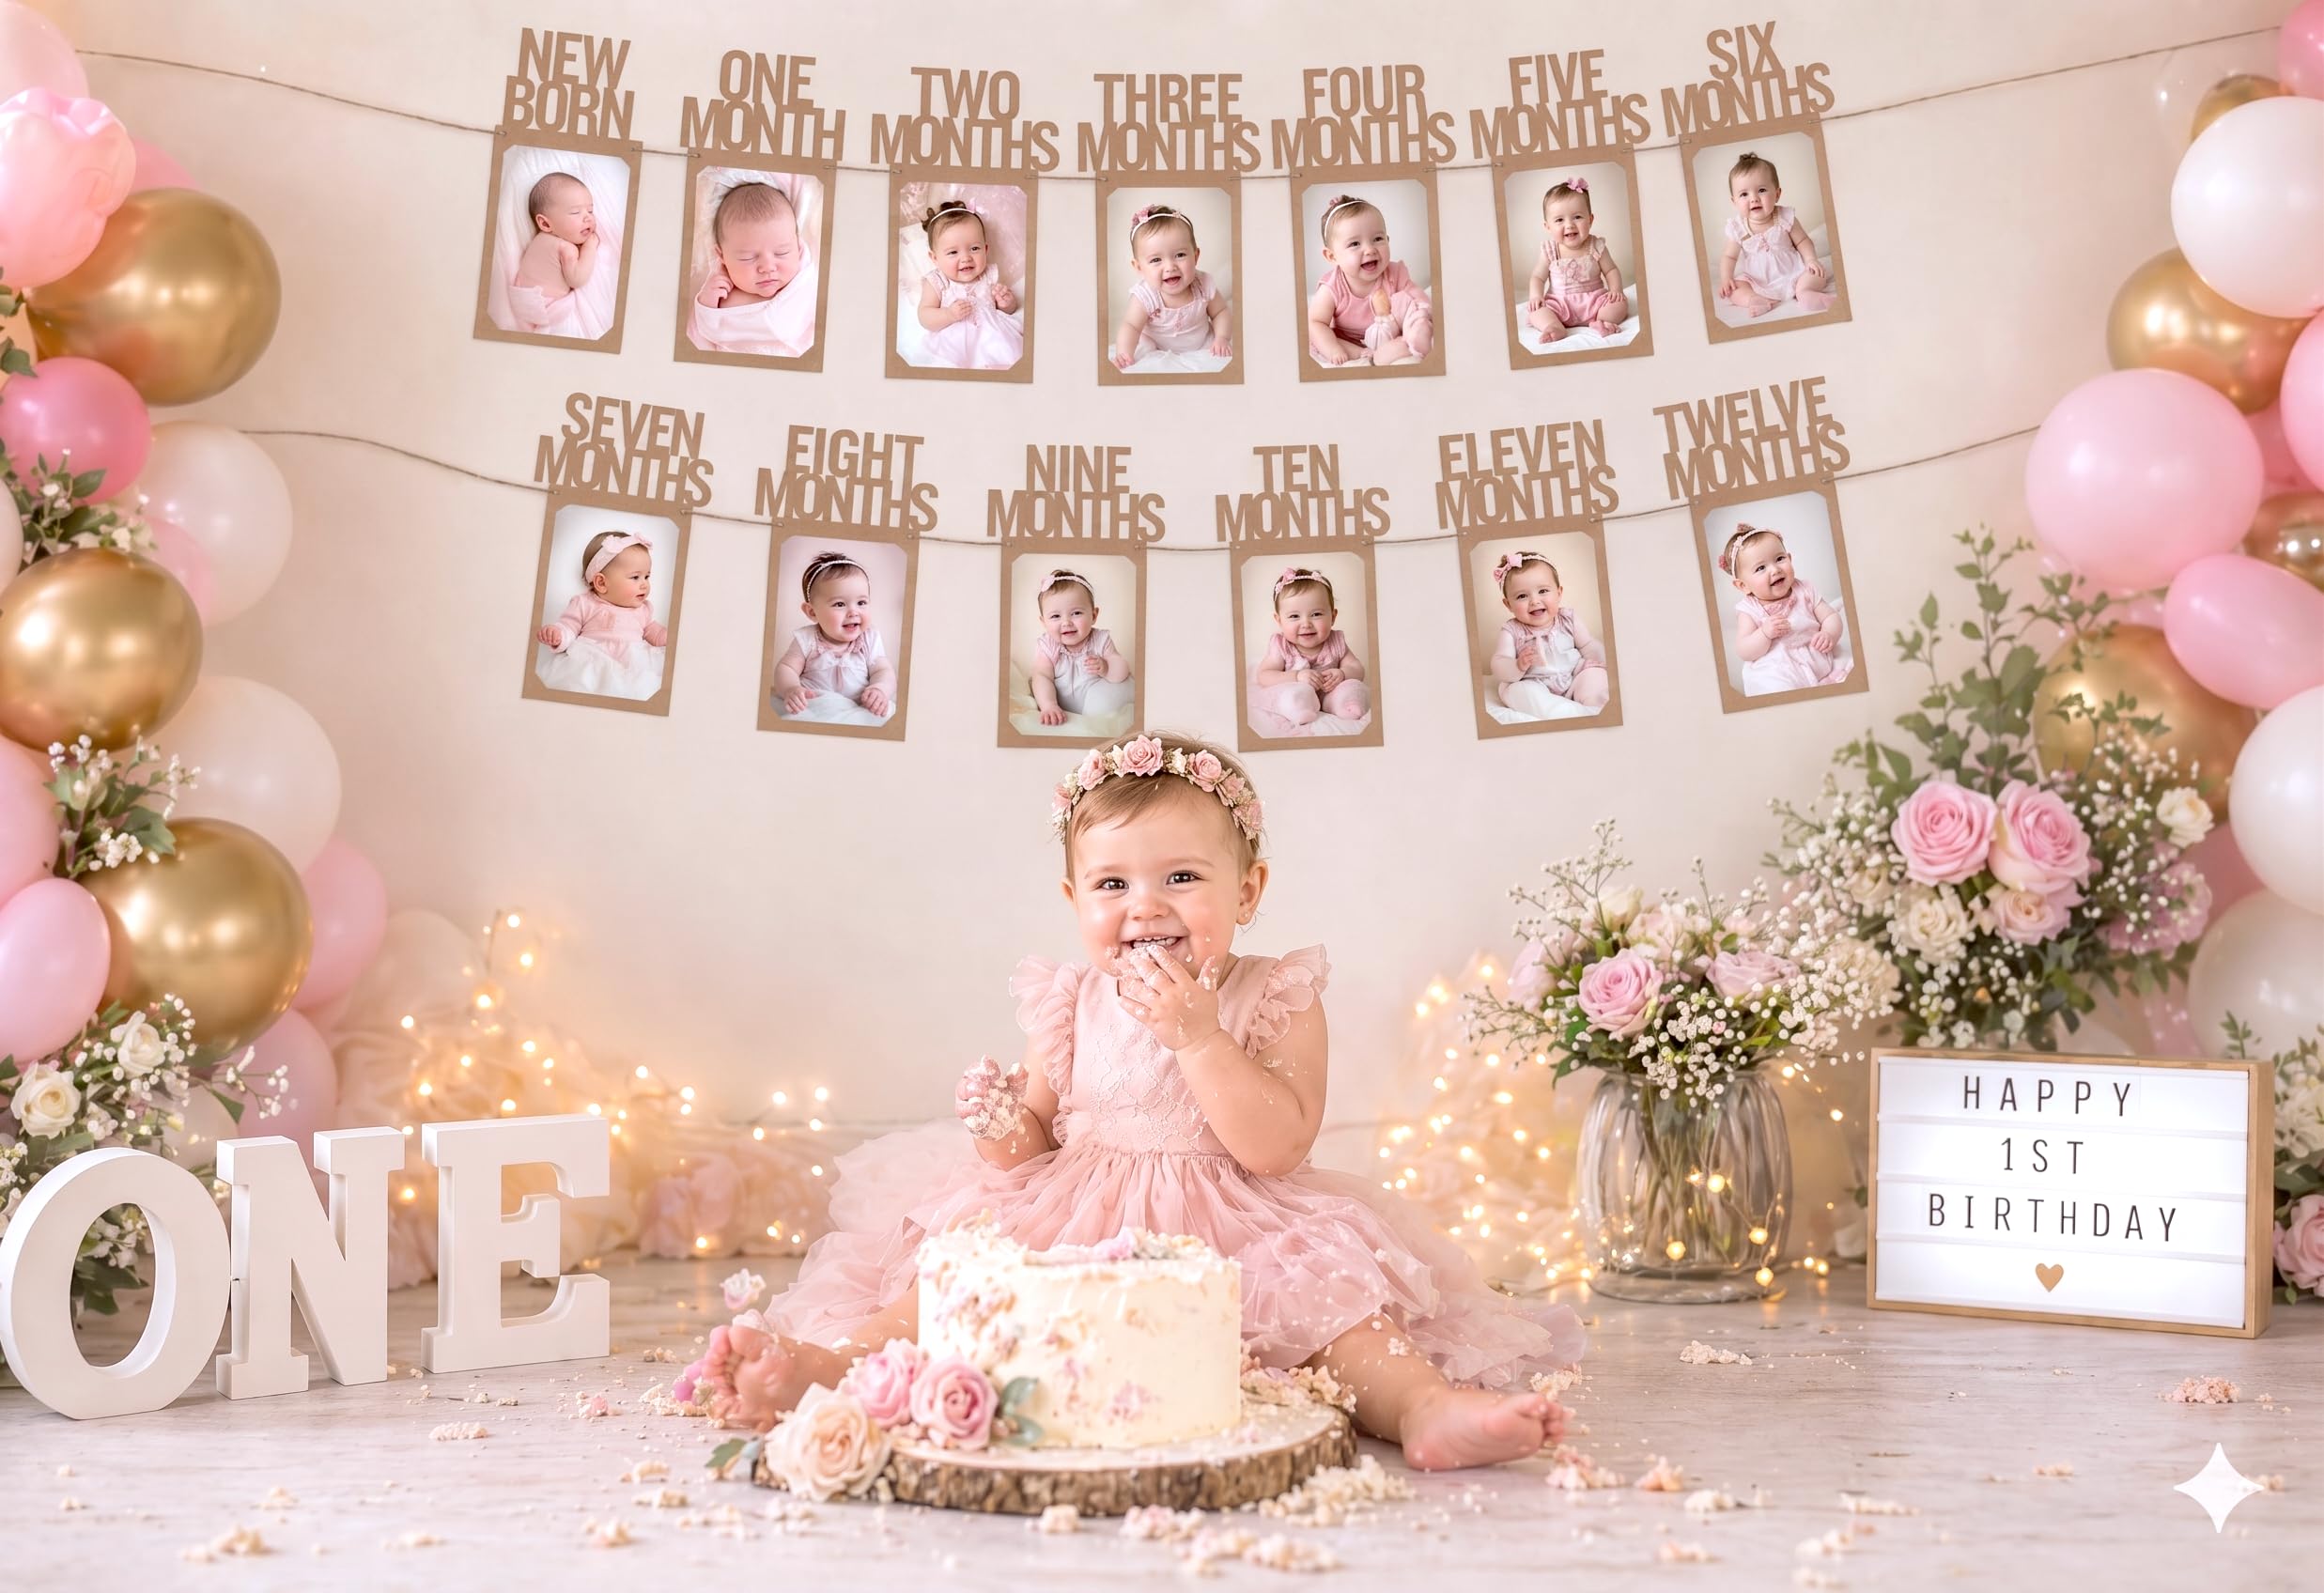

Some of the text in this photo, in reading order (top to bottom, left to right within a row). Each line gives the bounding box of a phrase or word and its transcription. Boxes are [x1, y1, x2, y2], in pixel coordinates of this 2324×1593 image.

[517, 27, 631, 88] NEW
[719, 49, 816, 108] ONE
[1508, 48, 1607, 108] FIVE
[1706, 21, 1783, 82] SIX
[504, 74, 635, 139] BORN
[910, 67, 1020, 120] TWO
[1094, 72, 1243, 124] THREE
[1303, 64, 1425, 120] FOUR
[1661, 61, 1836, 137] MONTHS
[680, 96, 845, 161] MONTH
[870, 113, 1060, 171] MONTHS
[1077, 120, 1262, 172] MONTHS
[1272, 111, 1456, 169] MONTHS
[1469, 92, 1651, 159] MONTHS
[561, 392, 705, 458] SEVEN
[1652, 376, 1833, 453] TWELVE
[534, 434, 714, 507] MONTHS
[787, 424, 924, 482] EIGHT
[1026, 444, 1132, 494] NINE
[1253, 443, 1340, 492] TEN
[1439, 418, 1605, 479] ELEVEN
[1664, 420, 1851, 500] MONTHS
[754, 467, 938, 532] MONTHS
[986, 488, 1165, 542] MONTHS
[1215, 487, 1390, 542] MONTHS
[1435, 463, 1619, 530] MONTHS
[1963, 1075, 2130, 1117] HAPPY
[2001, 1137, 2084, 1174] 1ST
[1929, 1193, 2176, 1242] BIRTHDAY
[0, 1113, 611, 1420] ONE
